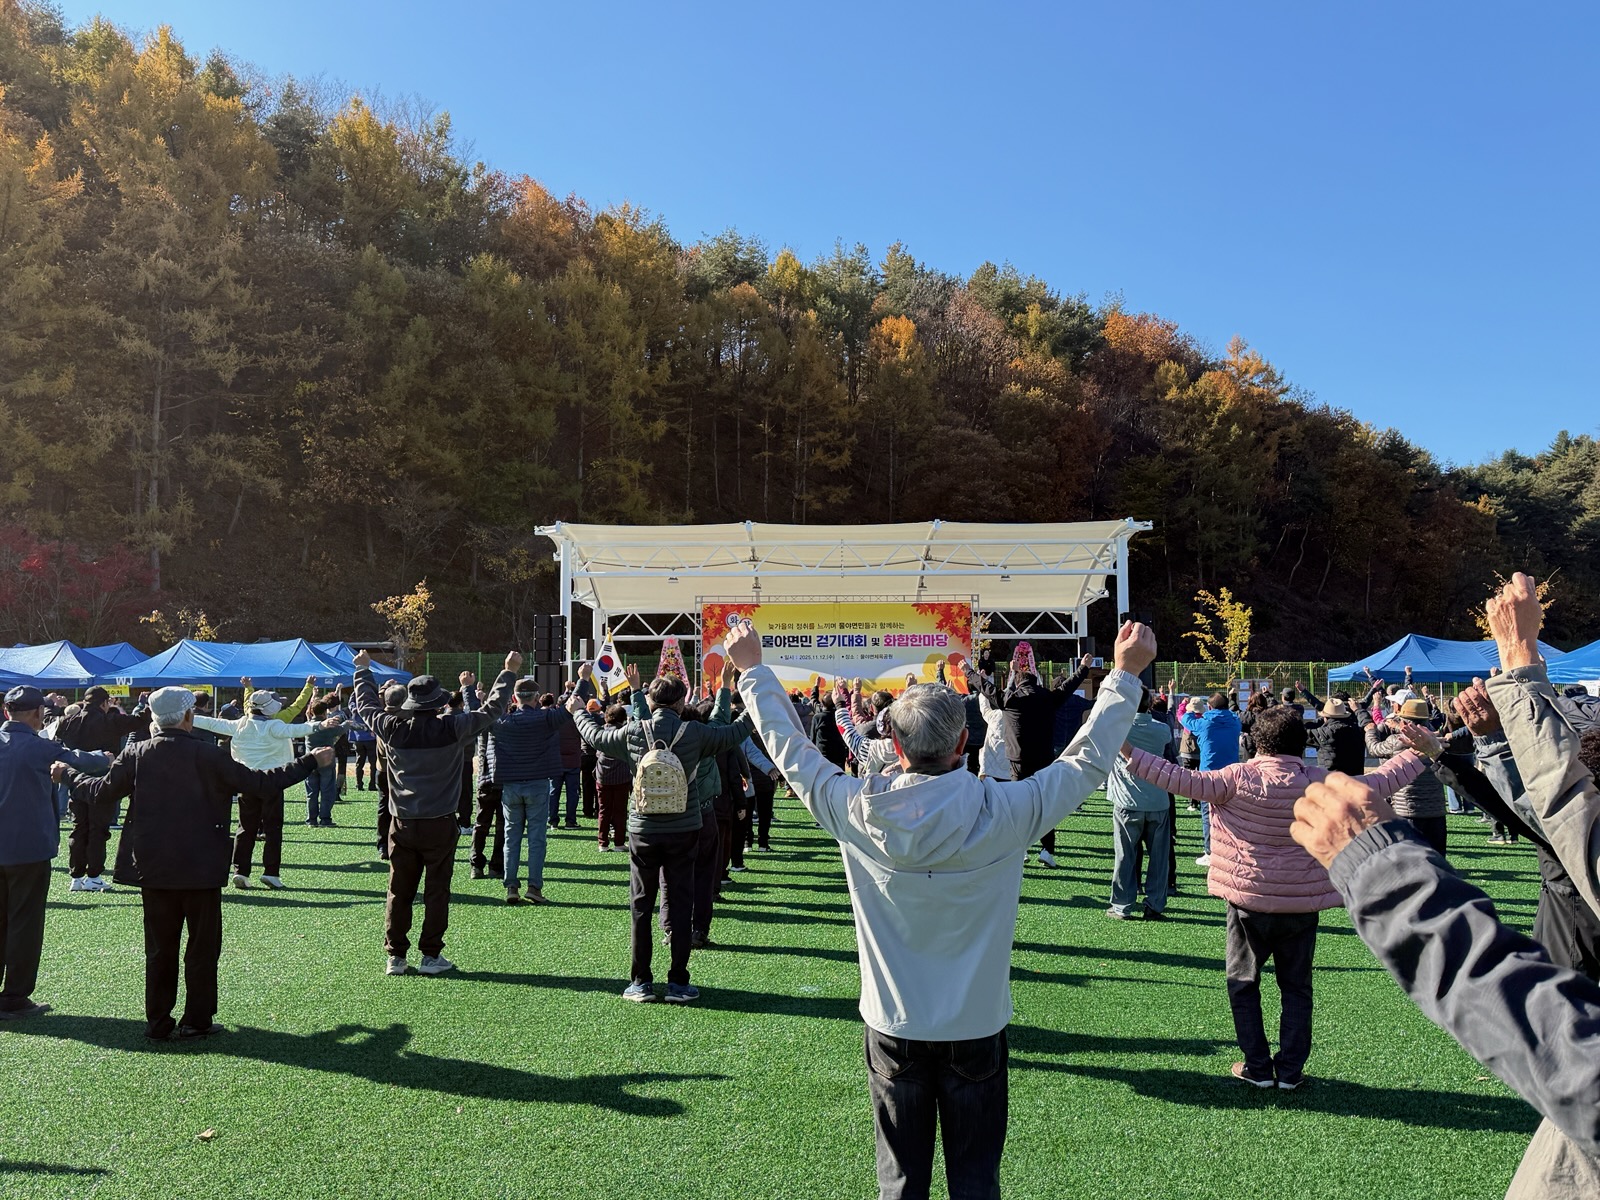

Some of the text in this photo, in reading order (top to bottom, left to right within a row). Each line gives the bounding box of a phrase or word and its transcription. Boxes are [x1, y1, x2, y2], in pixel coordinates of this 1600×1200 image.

[768, 622, 905, 630] 늦가을의 정취를 느끼며 물야면민들과 함께하는
[762, 634, 949, 647] 물야면민 걷기대회 및 화합한마당
[115, 677, 133, 686] WJ
